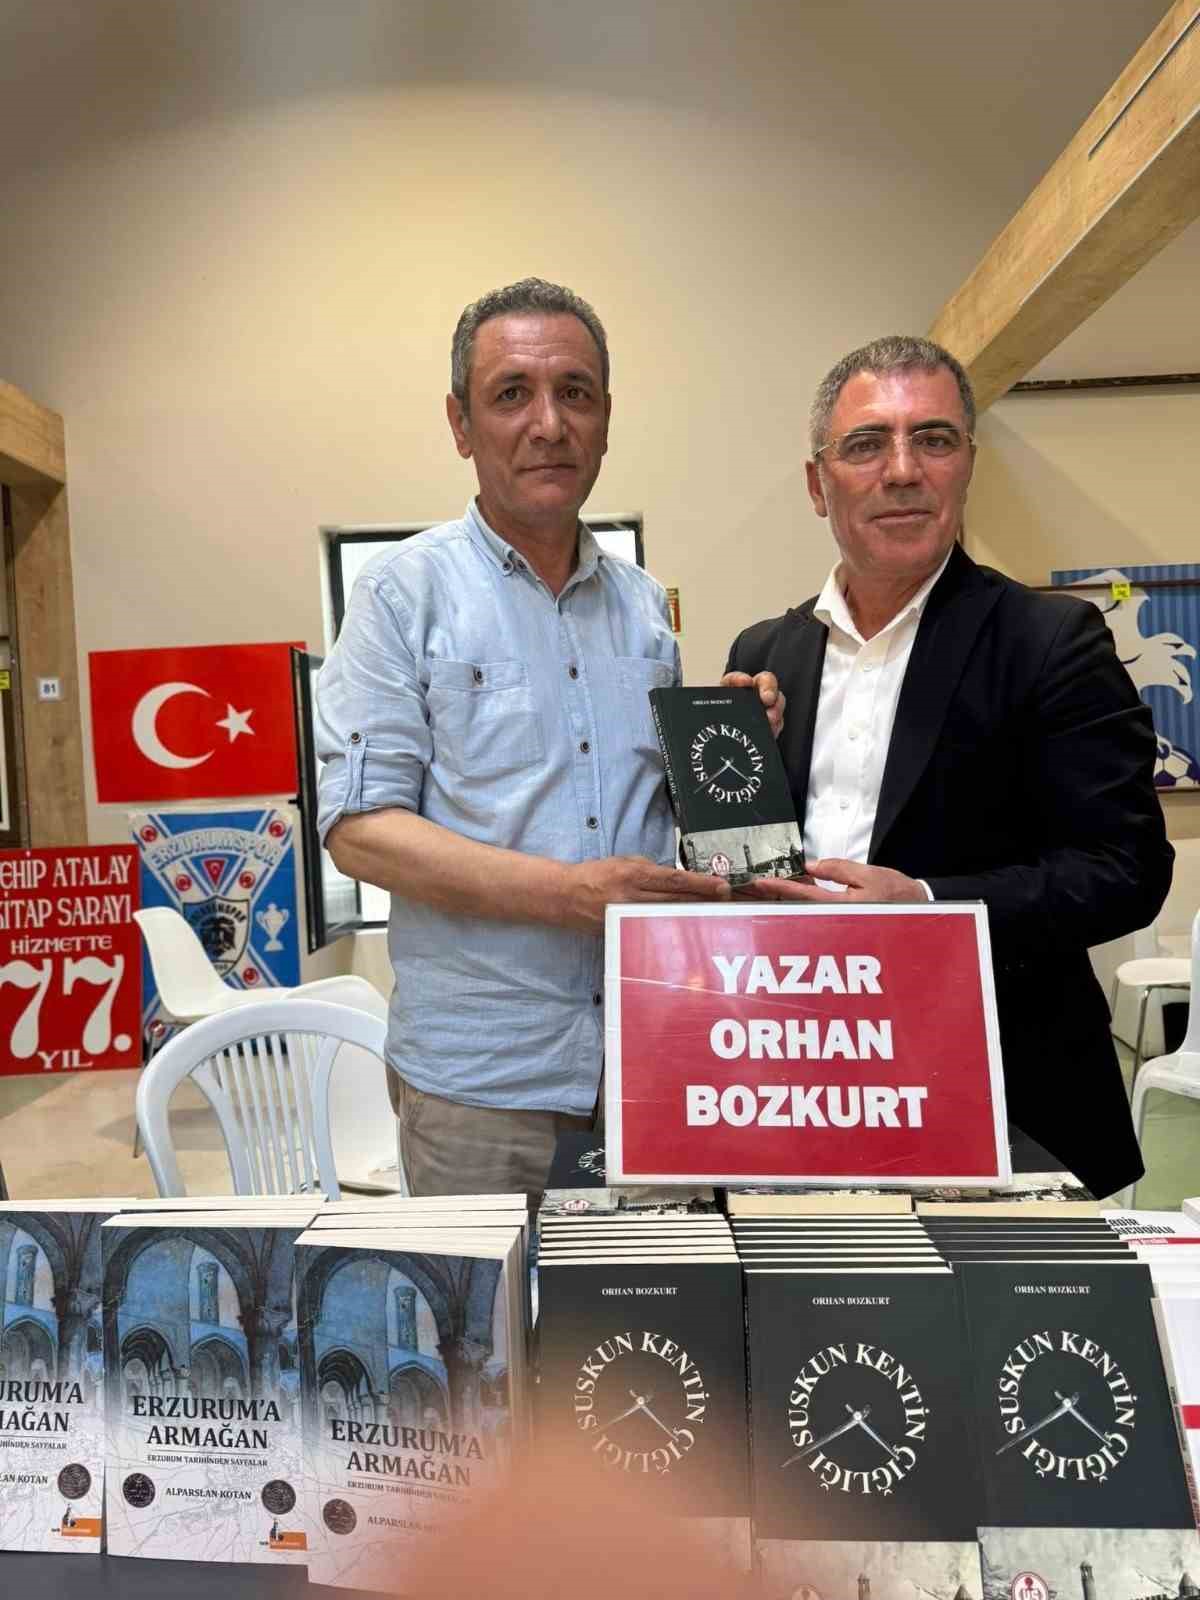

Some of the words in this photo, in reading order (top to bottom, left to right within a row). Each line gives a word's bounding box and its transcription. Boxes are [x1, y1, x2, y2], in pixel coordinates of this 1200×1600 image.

[691, 724, 718, 782] SUSKUN
[720, 723, 764, 774] KENTİN
[52, 855, 132, 888] ATALAY
[0, 891, 52, 929] İTAP
[57, 894, 131, 926] SARAYI
[10, 935, 112, 955] HİZMETTE
[712, 955, 883, 995] YAZAR
[709, 1018, 893, 1060] ORHAN
[37, 1048, 93, 1070] YIL
[686, 1085, 928, 1128] BOZKURT
[602, 1287, 634, 1296] ORHAN
[635, 1287, 678, 1296] BOZKURT
[812, 1297, 845, 1305] ORHAN
[847, 1297, 891, 1305] BOZKURT
[1014, 1285, 1047, 1294] ORHAN
[1047, 1285, 1090, 1294] BOZKURT
[574, 1332, 634, 1432] SUSKUN
[640, 1331, 710, 1424] KENTİN
[788, 1343, 849, 1448] SUSKUN
[855, 1342, 931, 1442] KENTİN
[999, 1331, 1054, 1435] SUSKUN
[1060, 1330, 1138, 1428] KENTİN
[132, 1395, 281, 1422] ERZURUM'A
[147, 1424, 268, 1450] ARMAĞAN
[331, 1419, 484, 1460] ERZURUM'A
[147, 1454, 183, 1463] ERZURUM
[347, 1451, 471, 1486] ARMAĞAN
[808, 1445, 917, 1497] ÇIĞLIĞI
[1022, 1431, 1129, 1483] ÇIĞLIĞI
[17, 1474, 48, 1484] KOTAN
[166, 1487, 218, 1499] ALPARSLAN
[219, 1488, 252, 1499] KOTAN
